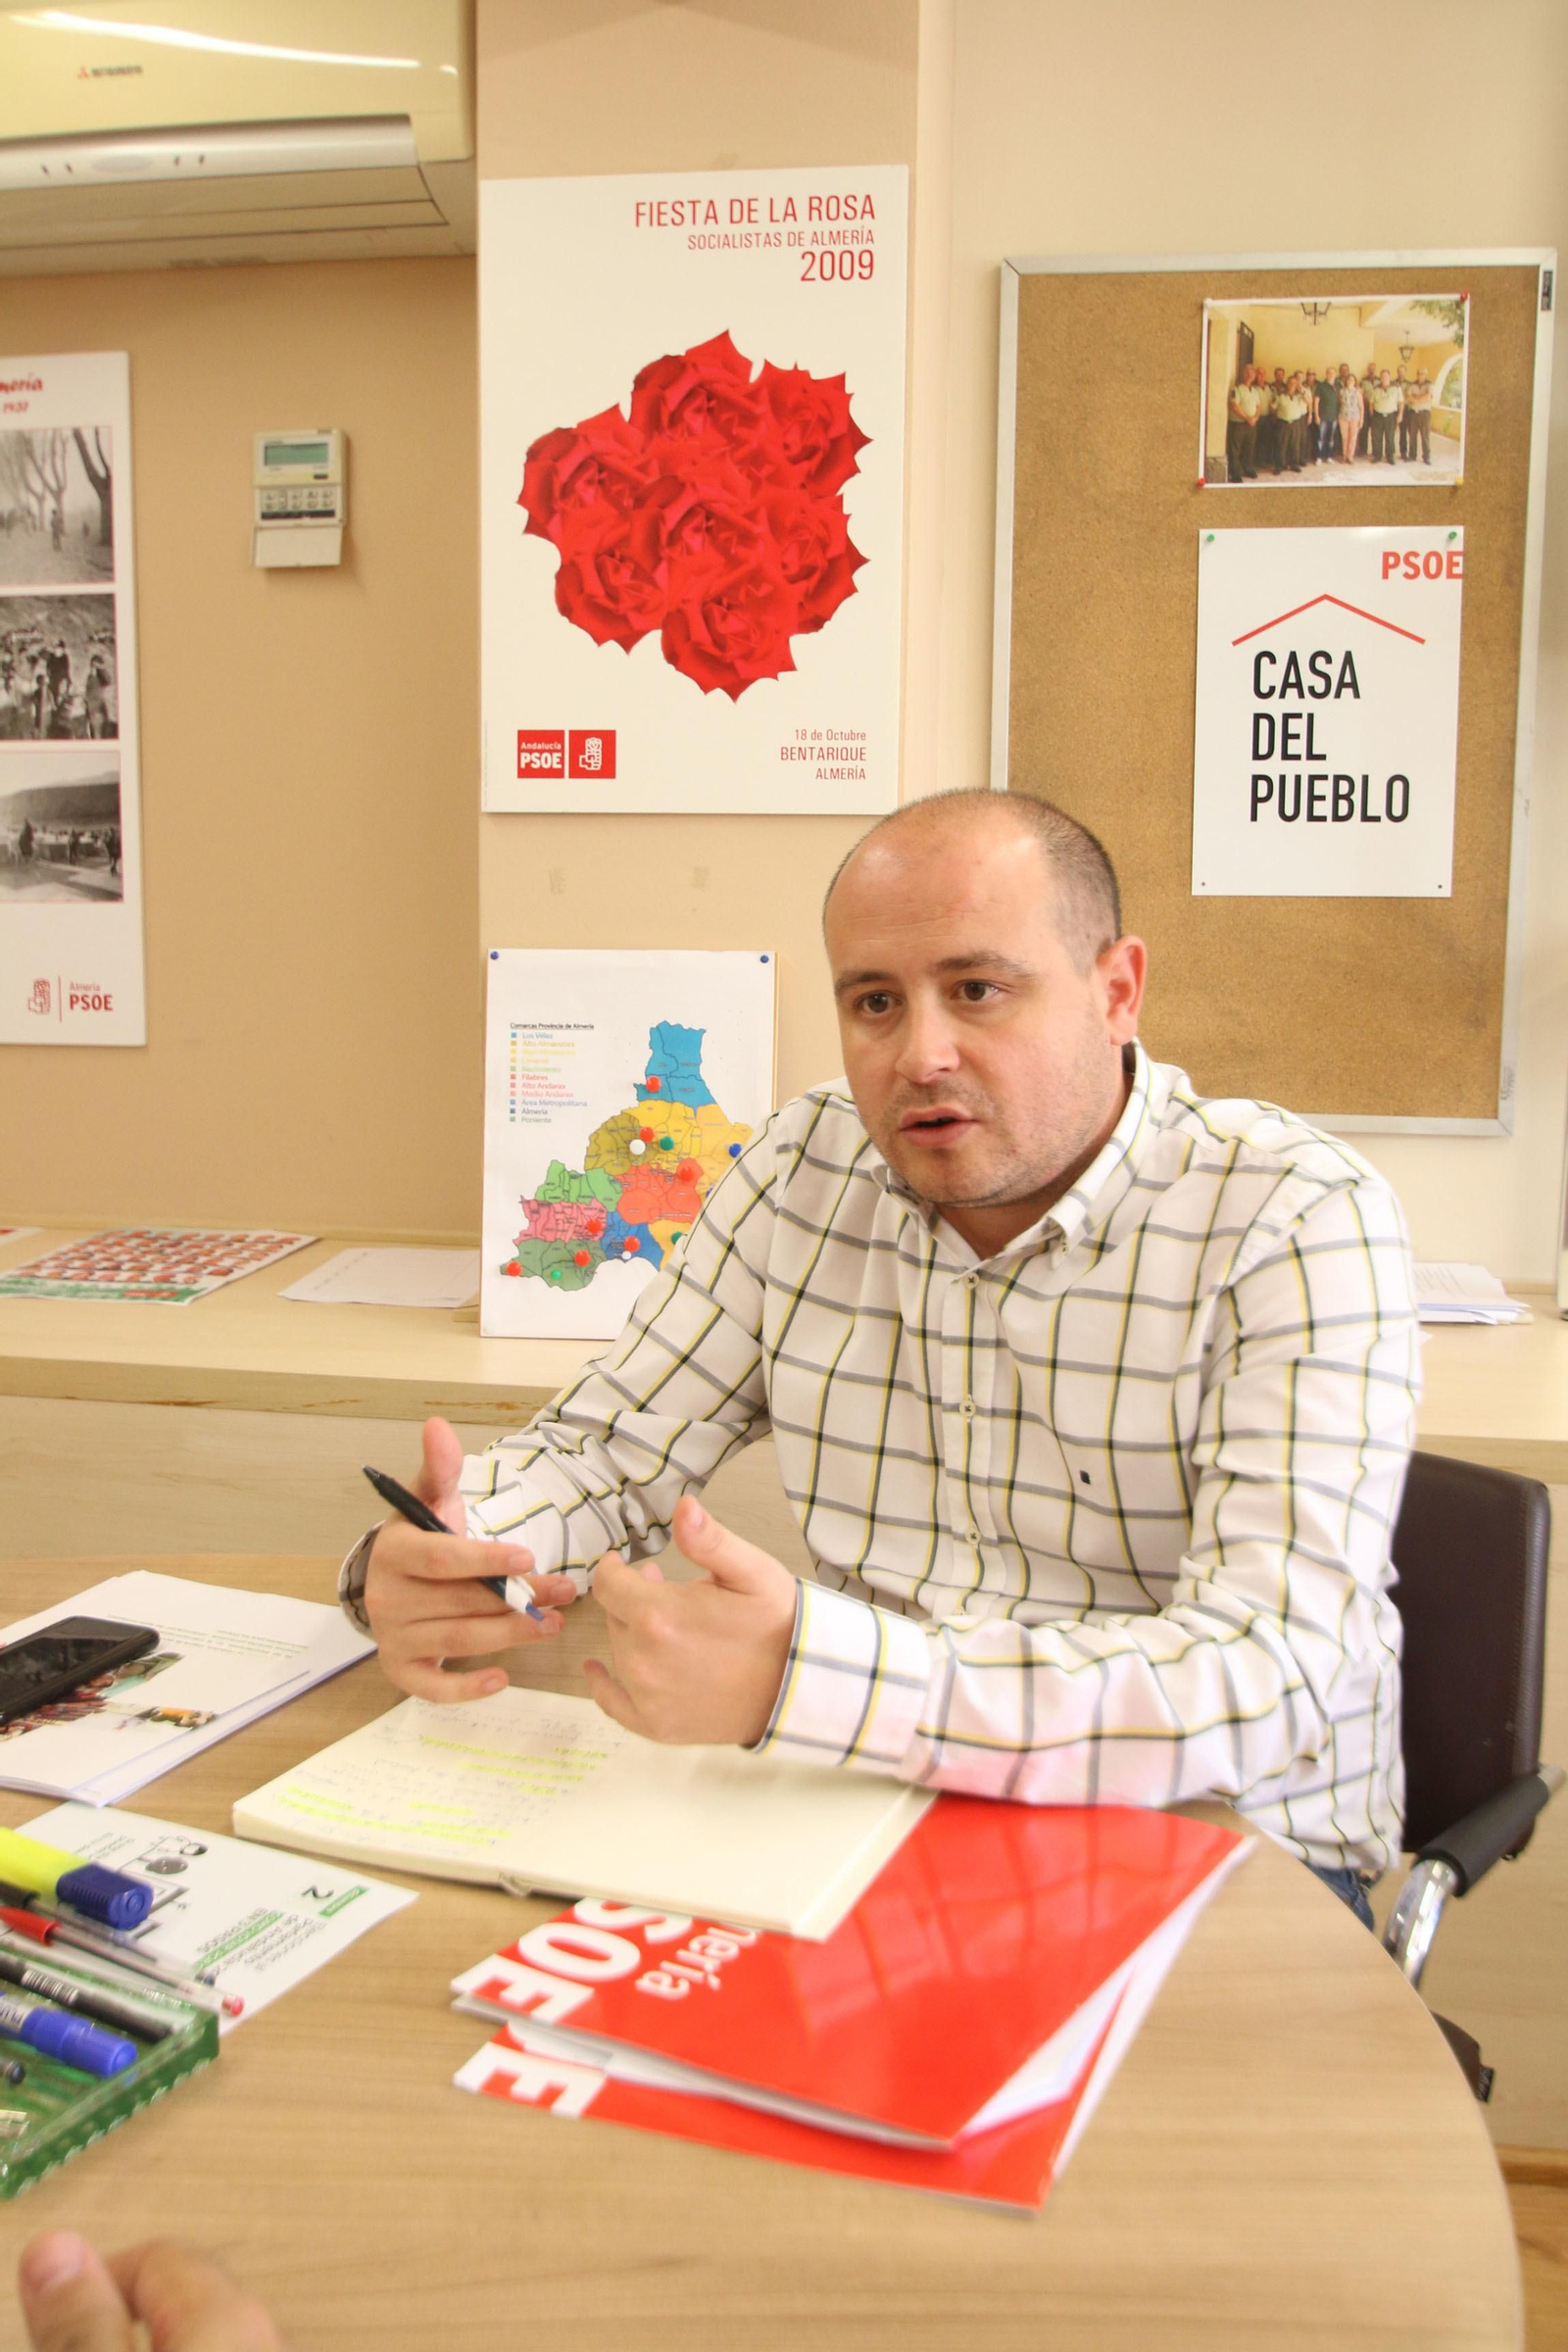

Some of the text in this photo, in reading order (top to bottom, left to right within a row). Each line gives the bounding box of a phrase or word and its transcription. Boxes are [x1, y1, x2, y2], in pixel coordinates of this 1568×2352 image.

[635, 194, 875, 227] FIESTA DE LA ROSA
[687, 225, 874, 251] SOCIALISTAS DE ALMERÍA
[801, 249, 874, 282] 2009
[1381, 550, 1463, 580] PSOE
[1253, 651, 1360, 700] CASA
[520, 741, 562, 751] Andalucía
[795, 729, 866, 742] 18 de Octubre
[1251, 712, 1327, 760] DEL
[519, 752, 563, 769] PSOE
[781, 747, 867, 761] BENTARIQUE
[815, 764, 866, 780] ALMERÍA
[1250, 774, 1410, 823] PUEBLO
[69, 994, 114, 1011] PSOE
[301, 1885, 334, 1899] 2
[450, 1896, 693, 2023] SOE
[635, 1924, 761, 2000] mería
